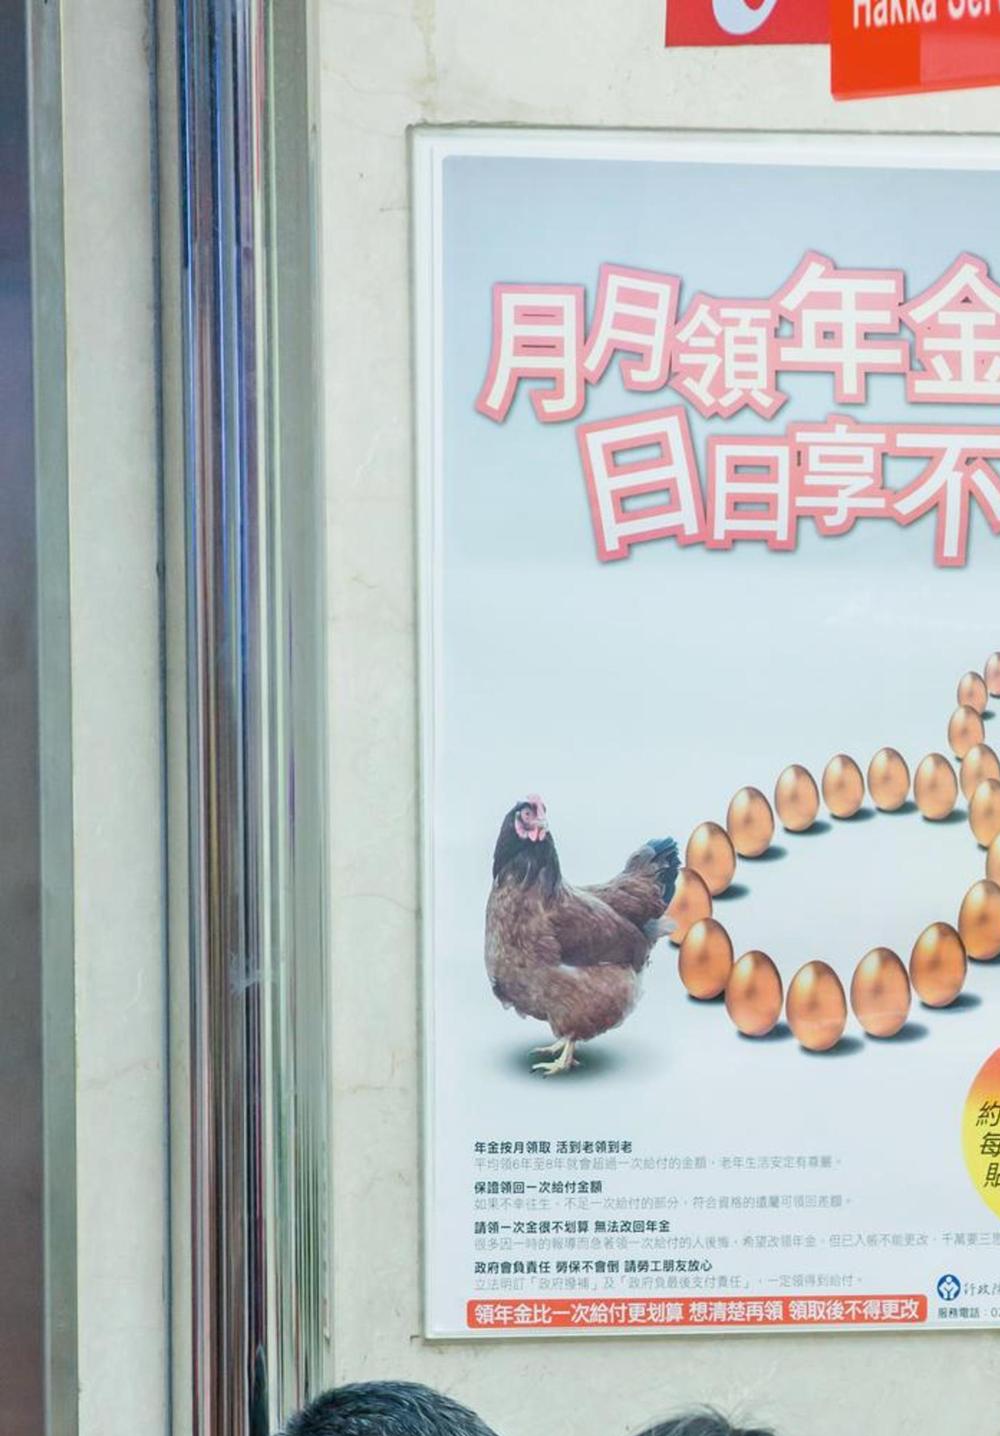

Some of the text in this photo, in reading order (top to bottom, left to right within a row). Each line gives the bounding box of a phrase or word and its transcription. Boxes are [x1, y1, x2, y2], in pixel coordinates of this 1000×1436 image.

[474, 1140, 633, 1155] 年金按月領取 活到老領到老
[474, 1180, 602, 1195] 保證領回一次給付金額
[474, 1219, 671, 1235] 請領一次金很不划算 無法改回年金
[474, 1258, 713, 1275] 政府會負責任 勞保不會倒 請勞工朋友放心
[474, 1298, 919, 1325] 領年金比一次給付更划算 想清楚再領 領取後不得更改
